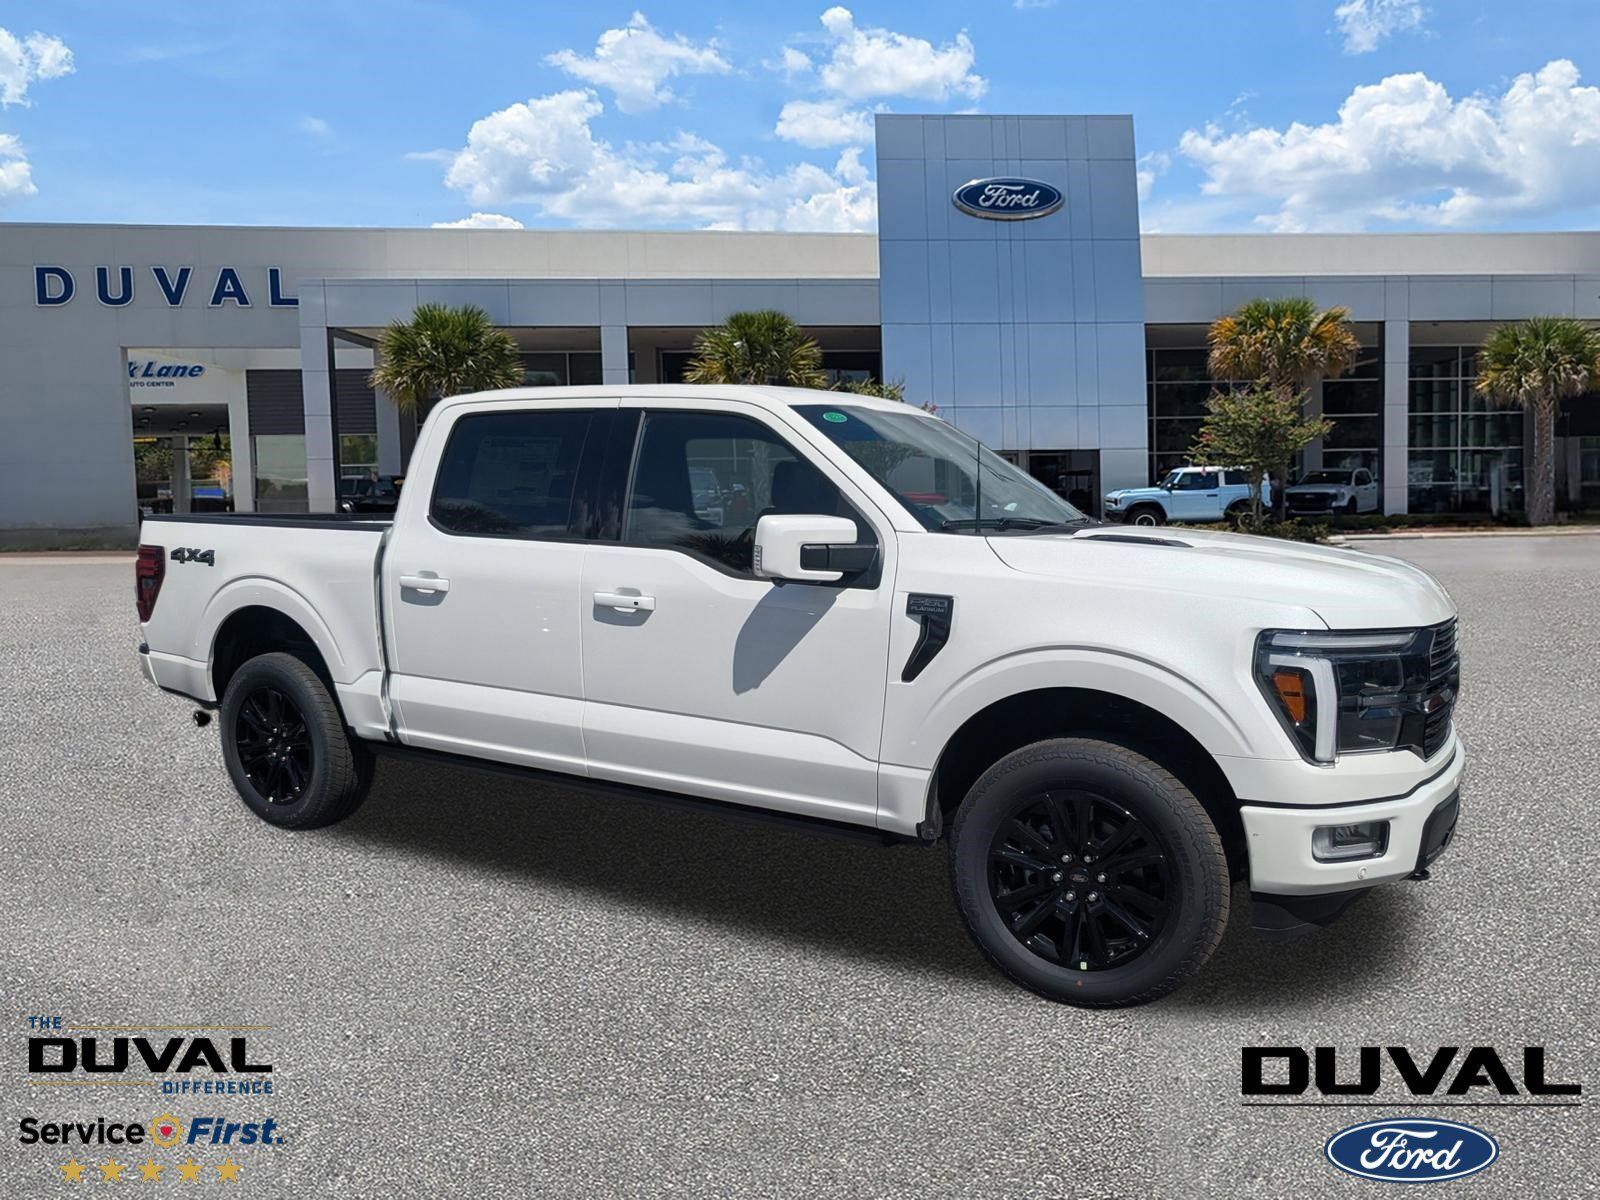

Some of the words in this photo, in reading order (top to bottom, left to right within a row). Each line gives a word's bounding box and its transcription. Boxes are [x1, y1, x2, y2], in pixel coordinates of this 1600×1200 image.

[979, 185, 1040, 207] Ford
[34, 266, 299, 307] DUVAL
[141, 361, 205, 378] Lane
